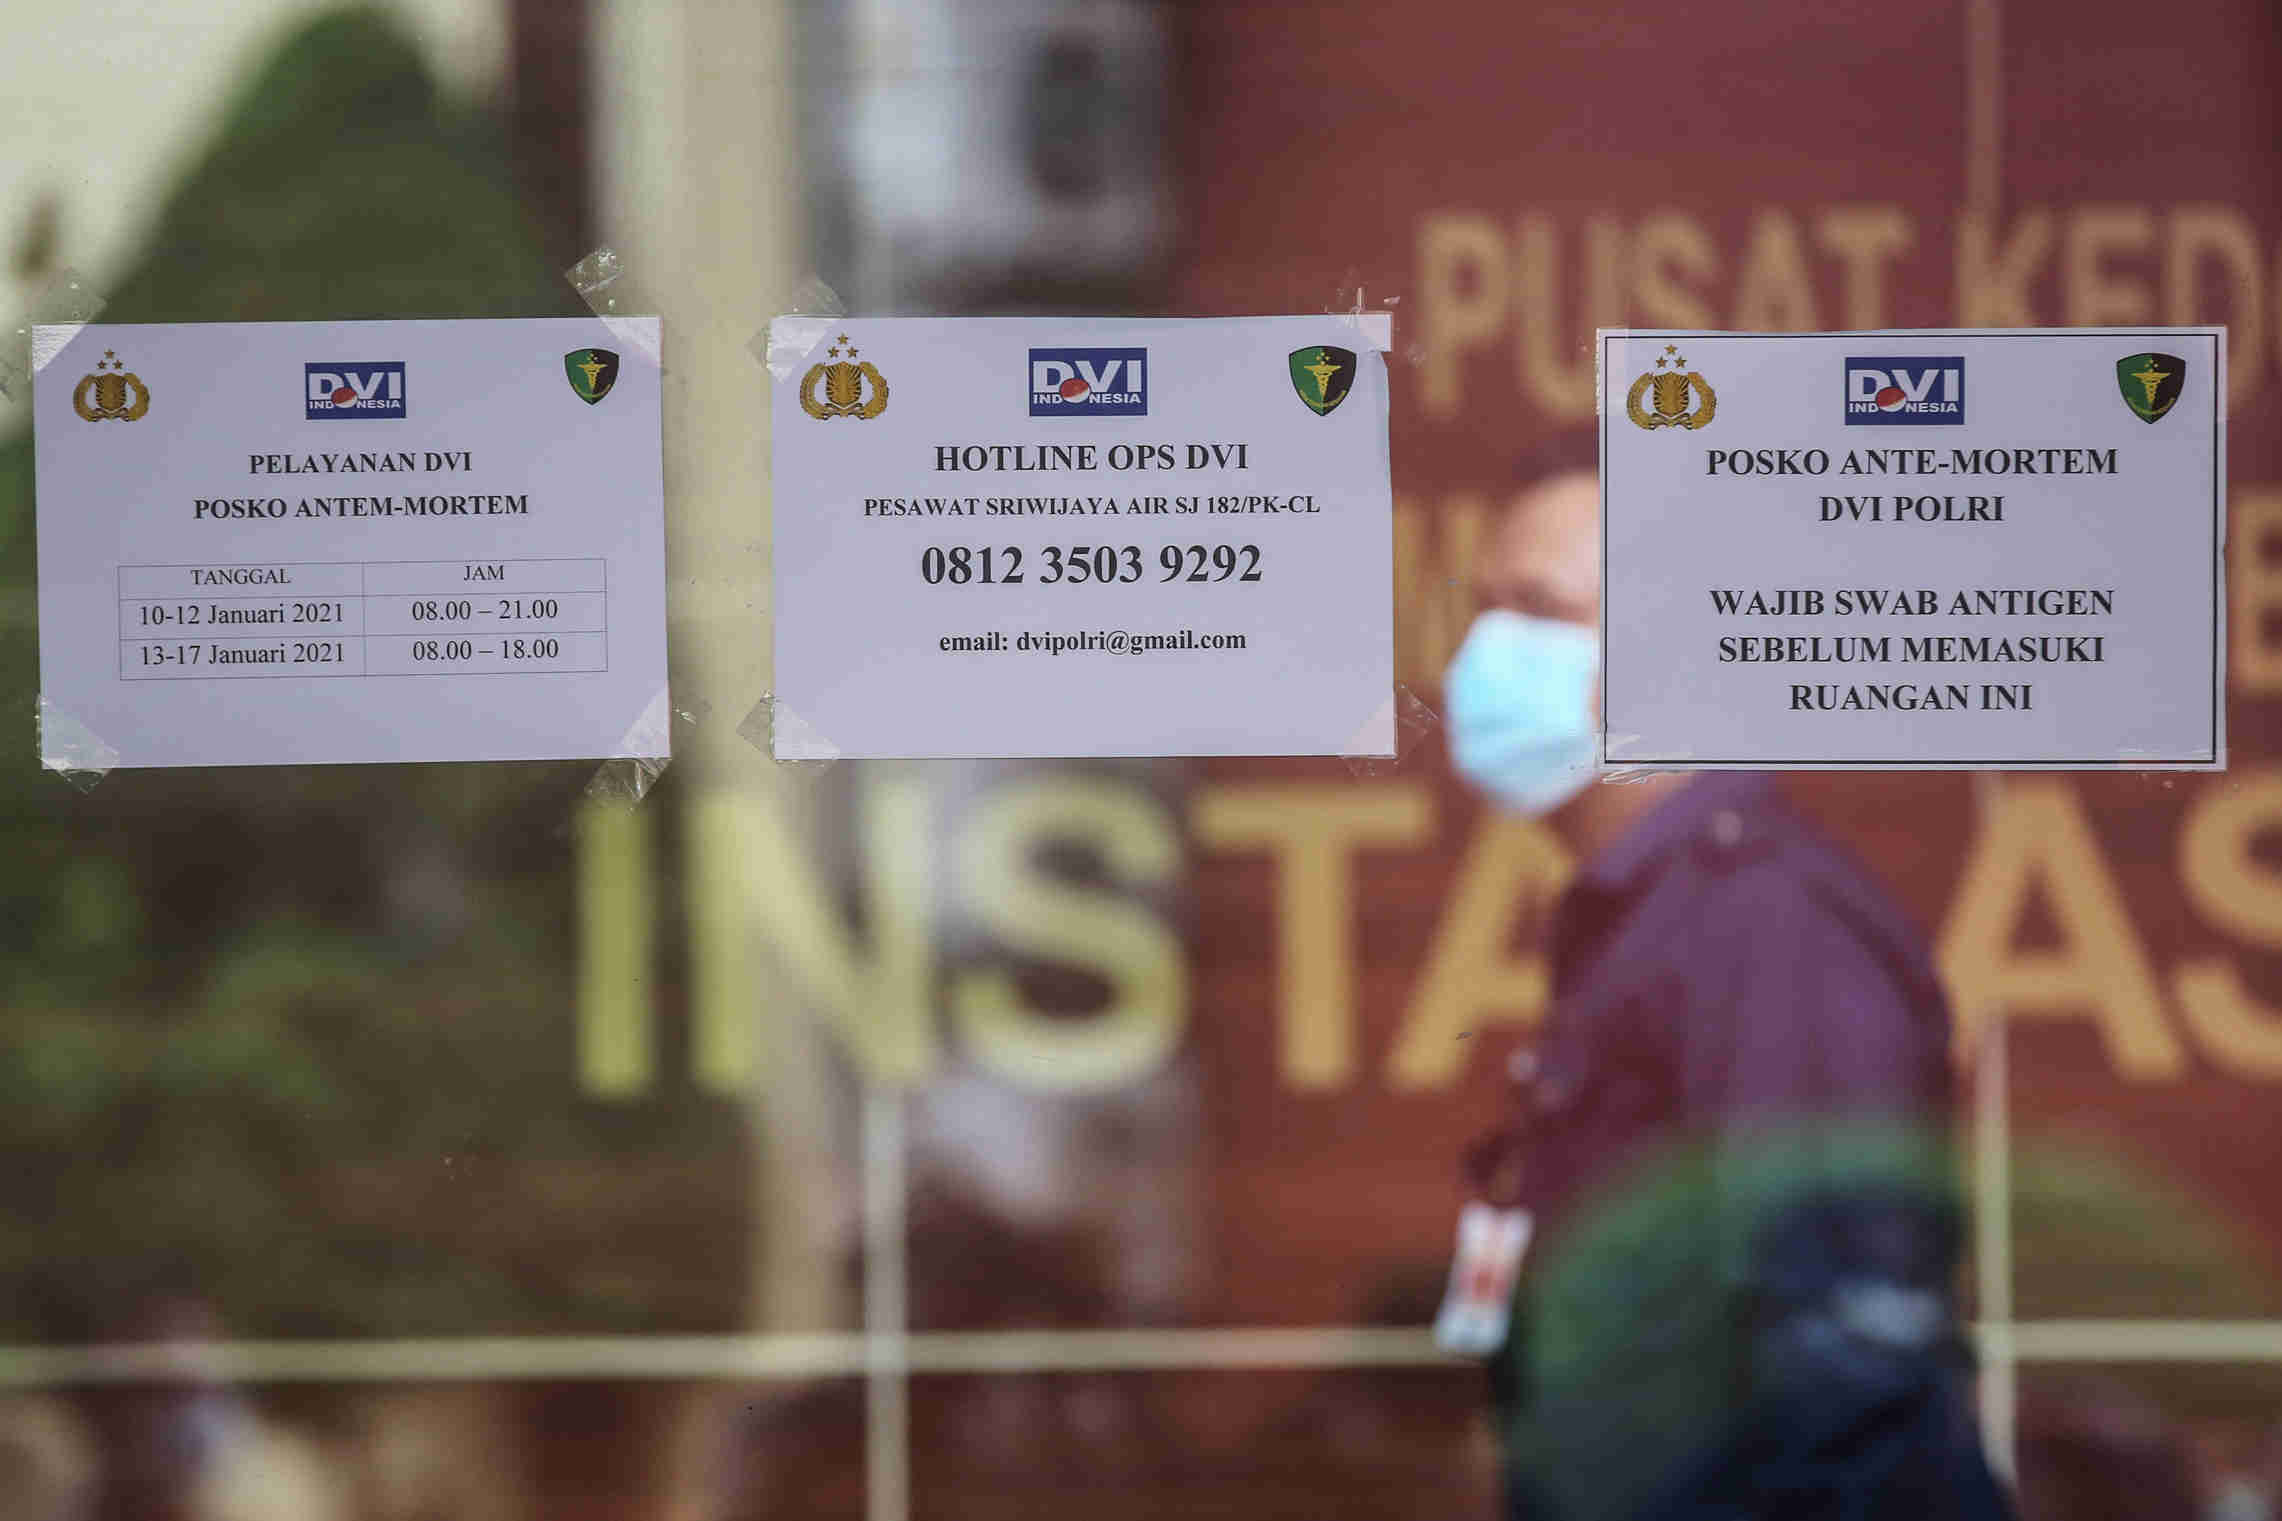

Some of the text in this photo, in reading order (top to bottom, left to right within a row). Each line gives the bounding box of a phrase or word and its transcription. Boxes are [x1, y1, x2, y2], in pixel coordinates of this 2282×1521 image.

[309, 372, 402, 400] DVI
[1032, 359, 1142, 393] DVI
[1848, 368, 1960, 402] DVI
[247, 451, 473, 475] PELAYANAN DVI
[933, 443, 1249, 472] HOTLINE OPS DVI
[1706, 448, 2120, 476] POSKO ANTE-MORTEM
[193, 494, 529, 520] POSKO ANTEM-MORTEM
[863, 495, 1321, 516] PESAWAT SRIWIJAYA AIR SJ 182/PK-CL
[1818, 495, 2006, 522] DVI POLRI
[190, 568, 292, 585] TANGGAL
[463, 565, 505, 581] JAM
[921, 544, 1263, 585] 0812 3503 9292
[139, 602, 344, 625] 10-12 Januari 2021
[411, 600, 472, 621] 08.00
[498, 598, 559, 620] 21.00
[1708, 589, 2116, 616] WAJIB SWAB ANTIGEN
[141, 642, 345, 665] 13-17 Januari 2021
[412, 640, 473, 661] 08.00
[501, 638, 560, 660] 18.00
[939, 629, 1247, 657] email: dvipolri@gmail.com
[1719, 636, 2105, 664] SEBELUM MEMASUKI
[1788, 684, 2033, 711] RUANGAN INI
